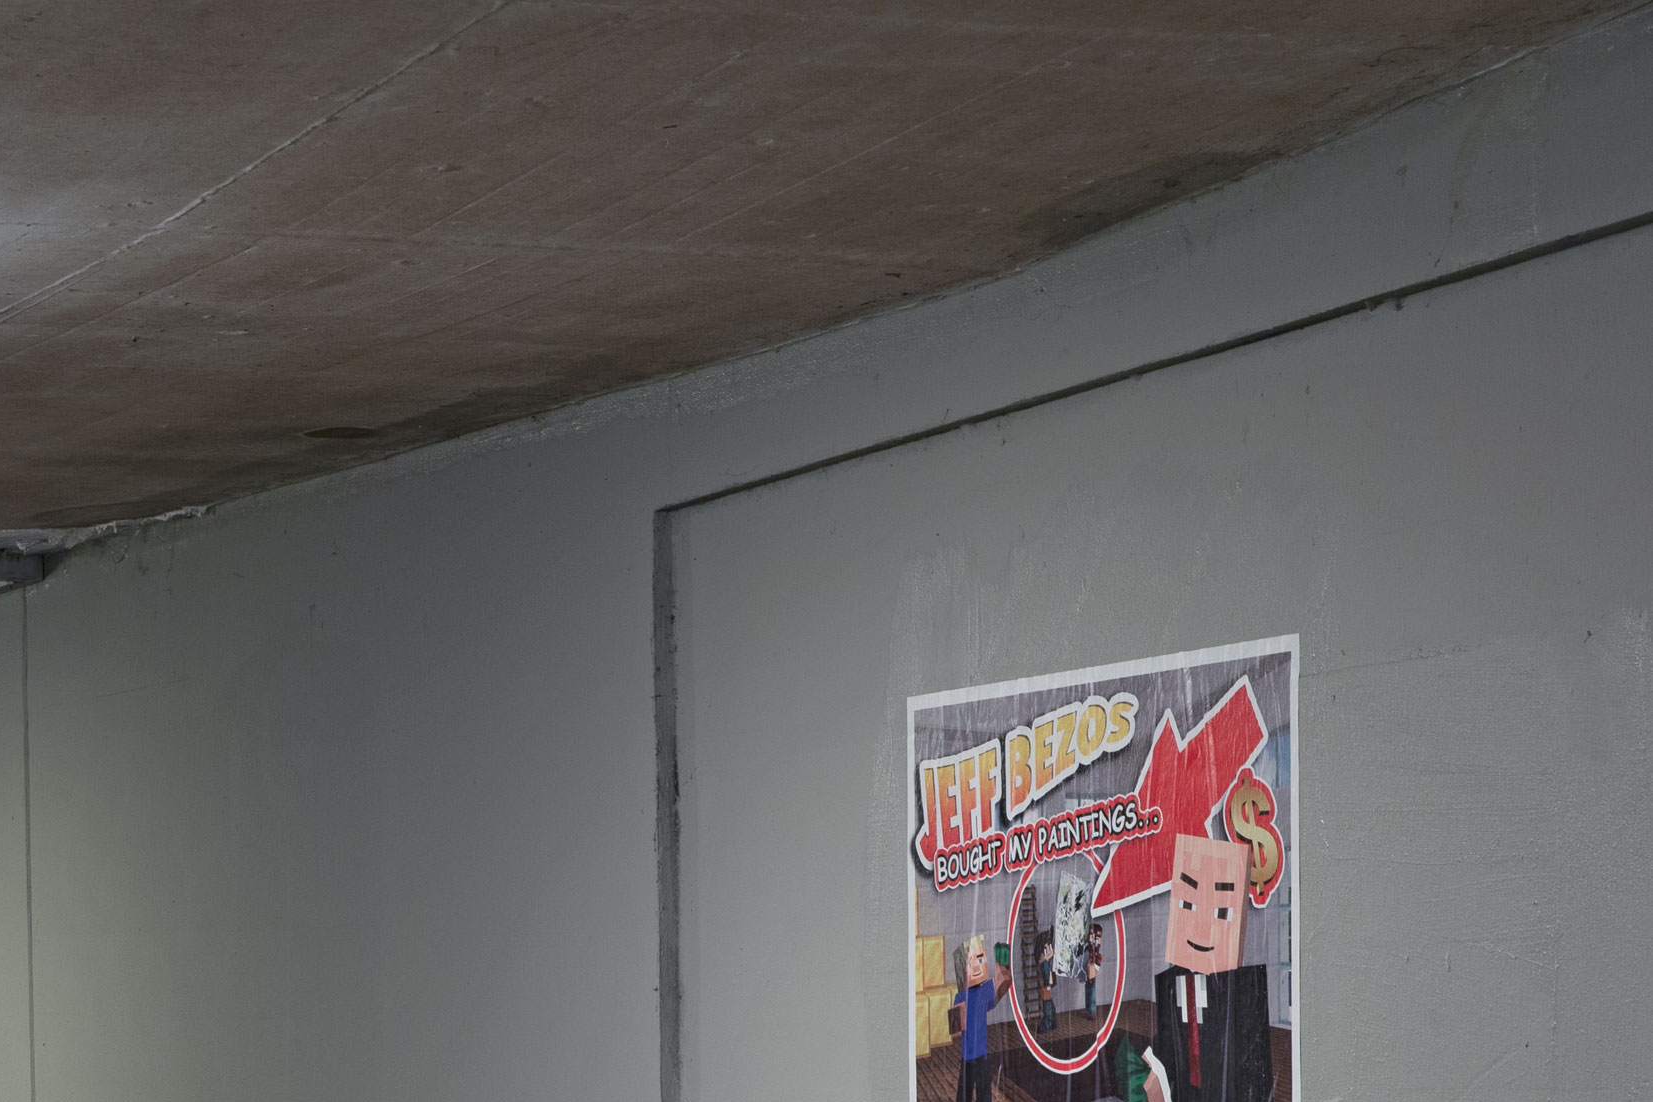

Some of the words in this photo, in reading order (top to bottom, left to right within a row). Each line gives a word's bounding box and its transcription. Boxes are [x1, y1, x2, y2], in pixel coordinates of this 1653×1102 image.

[918, 745, 999, 864] JEFF
[1008, 700, 1135, 814] BEZOS
[936, 839, 1003, 884] BOUGHT
[1007, 830, 1033, 864] MY
[1037, 801, 1159, 854] PAINTINGS...
